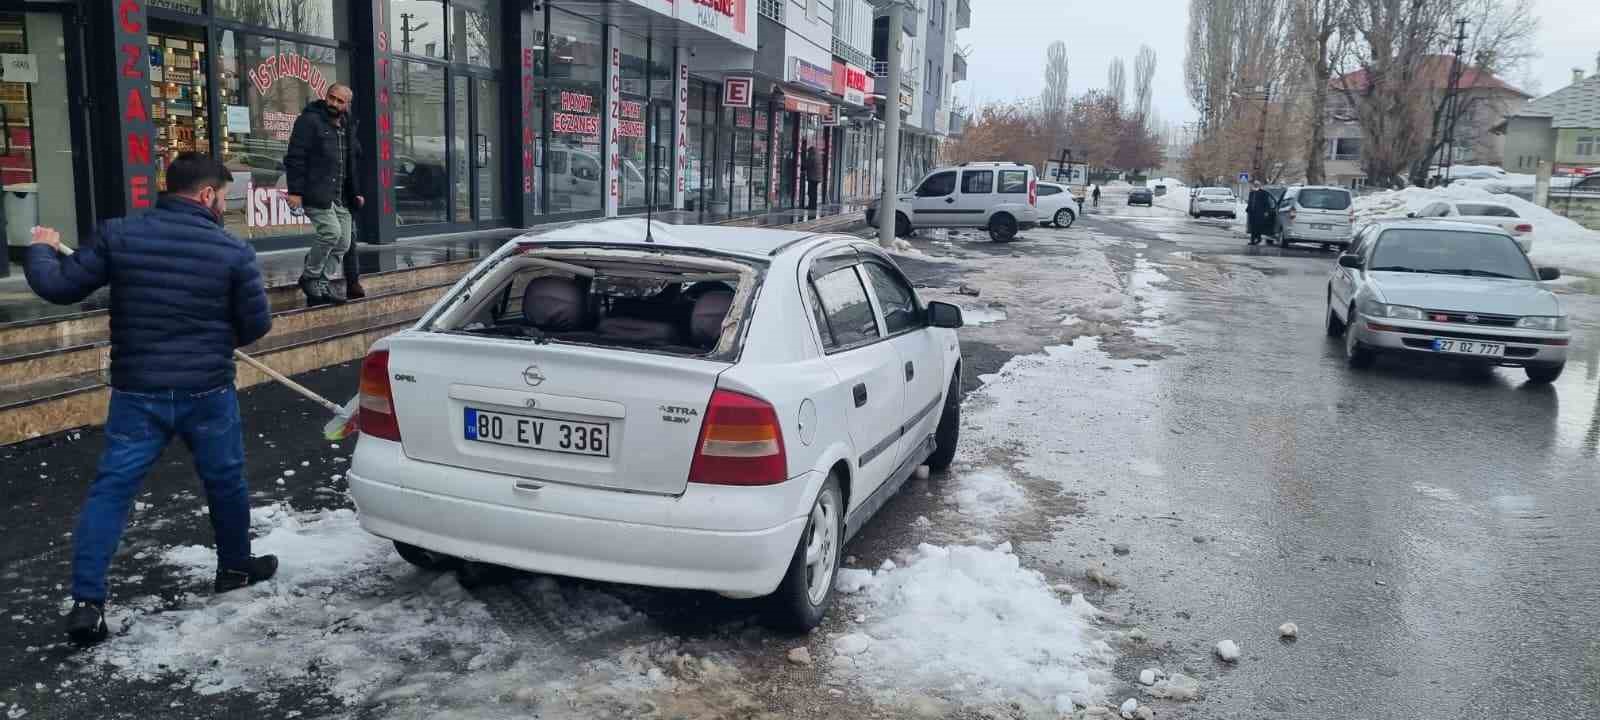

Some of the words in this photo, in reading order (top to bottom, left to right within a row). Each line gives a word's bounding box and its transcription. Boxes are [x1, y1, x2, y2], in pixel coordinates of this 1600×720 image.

[561, 91, 592, 113] HAYAT
[731, 82, 745, 101] E
[611, 48, 619, 196] ECZANE
[679, 65, 687, 192] ECZANE
[1441, 340, 1454, 351] 27
[1480, 343, 1499, 354] 777
[660, 405, 697, 415] ASTRA
[478, 414, 502, 440] 80
[517, 419, 544, 445] EV
[559, 424, 602, 451] 336
